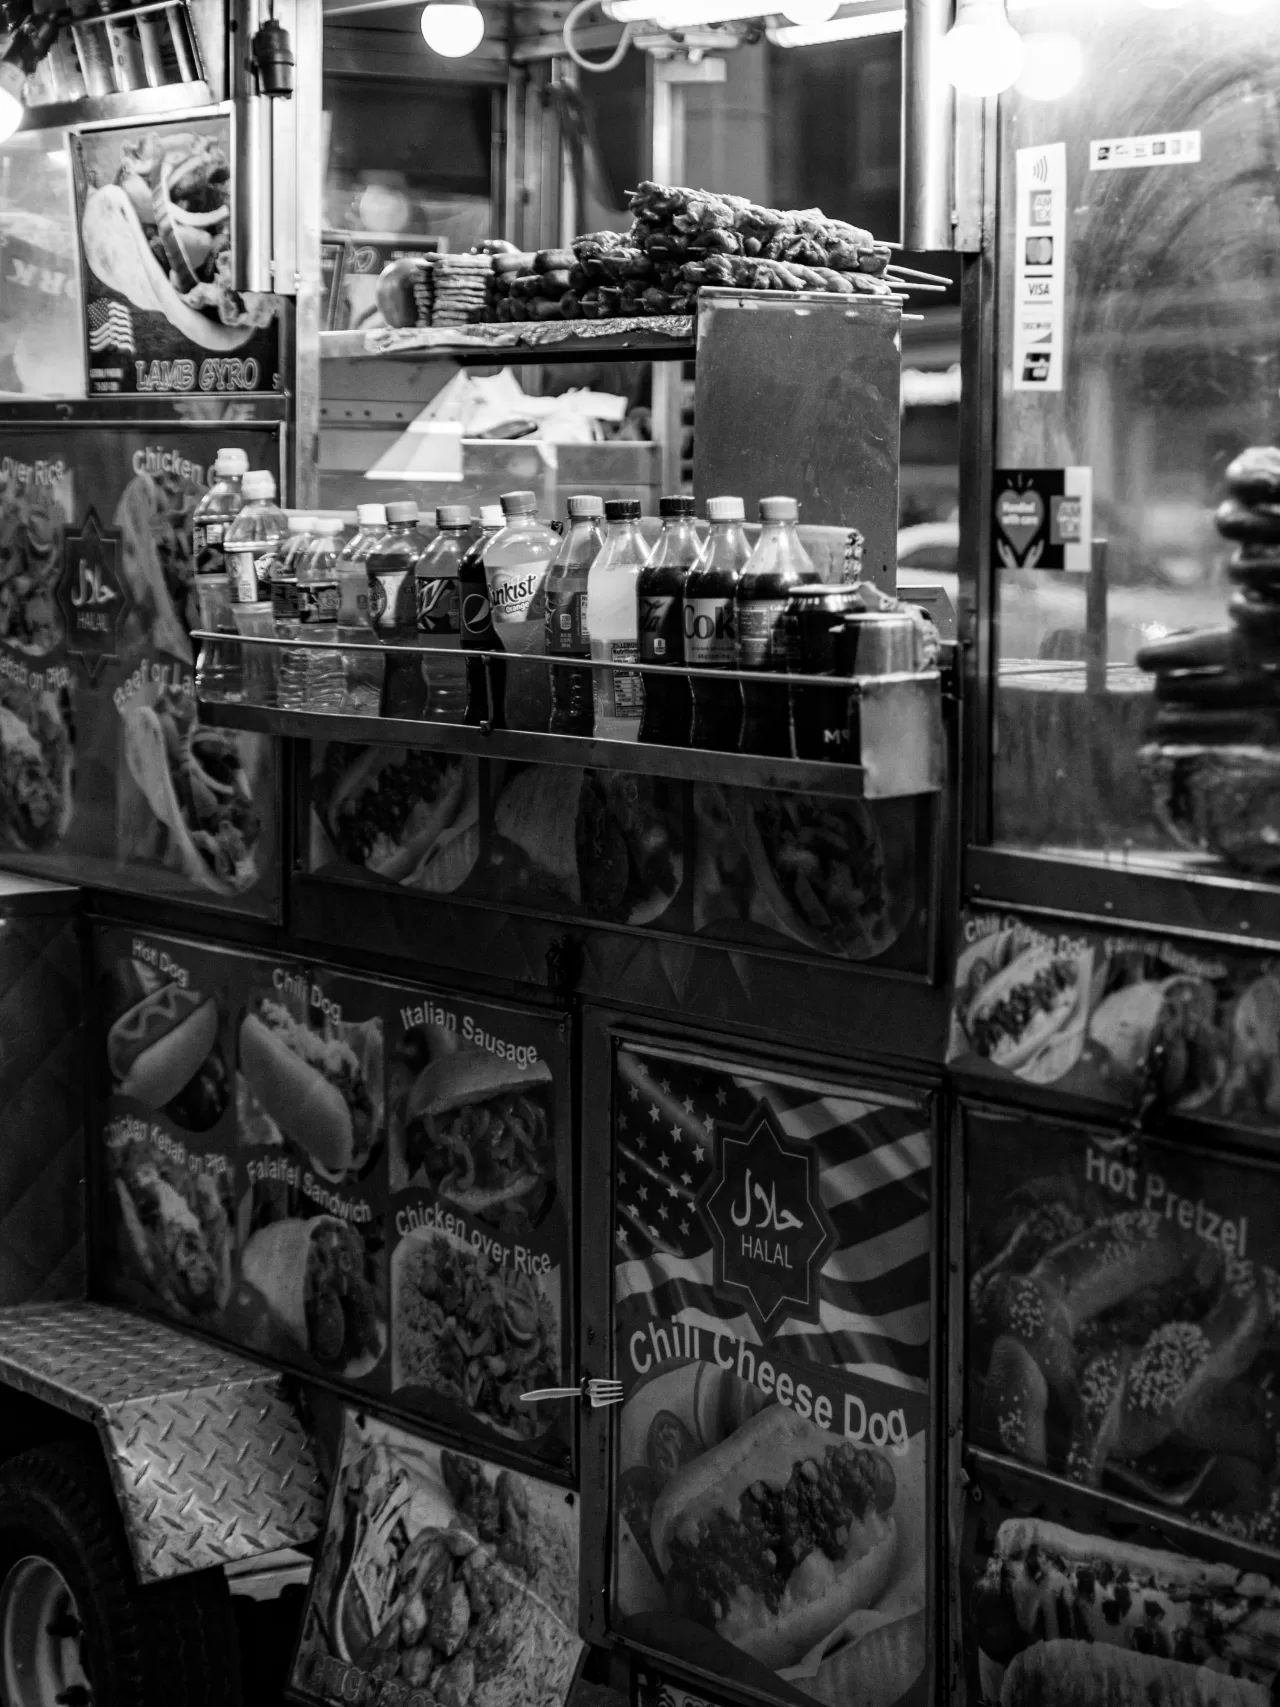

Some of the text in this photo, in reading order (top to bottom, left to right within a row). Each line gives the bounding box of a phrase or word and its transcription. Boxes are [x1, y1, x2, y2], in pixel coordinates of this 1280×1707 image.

[1027, 283, 1050, 296] VISA
[134, 358, 196, 392] LAMB
[198, 357, 261, 391] GYRO
[132, 446, 204, 484] Chicken
[71, 558, 116, 607] حلال
[504, 601, 531, 615] Orange
[132, 937, 191, 989] Hot Dog
[272, 967, 343, 1025] Chili Dog
[400, 999, 538, 1070] Italian Sausage
[301, 1172, 373, 1224] Sandwich
[730, 1167, 804, 1232] حلال
[1085, 1147, 1248, 1258] Hot Pretzel
[395, 1199, 553, 1278] Chicken over Rice
[740, 1233, 794, 1270] HALAL
[629, 1314, 910, 1457] Chili Cheese Dog
